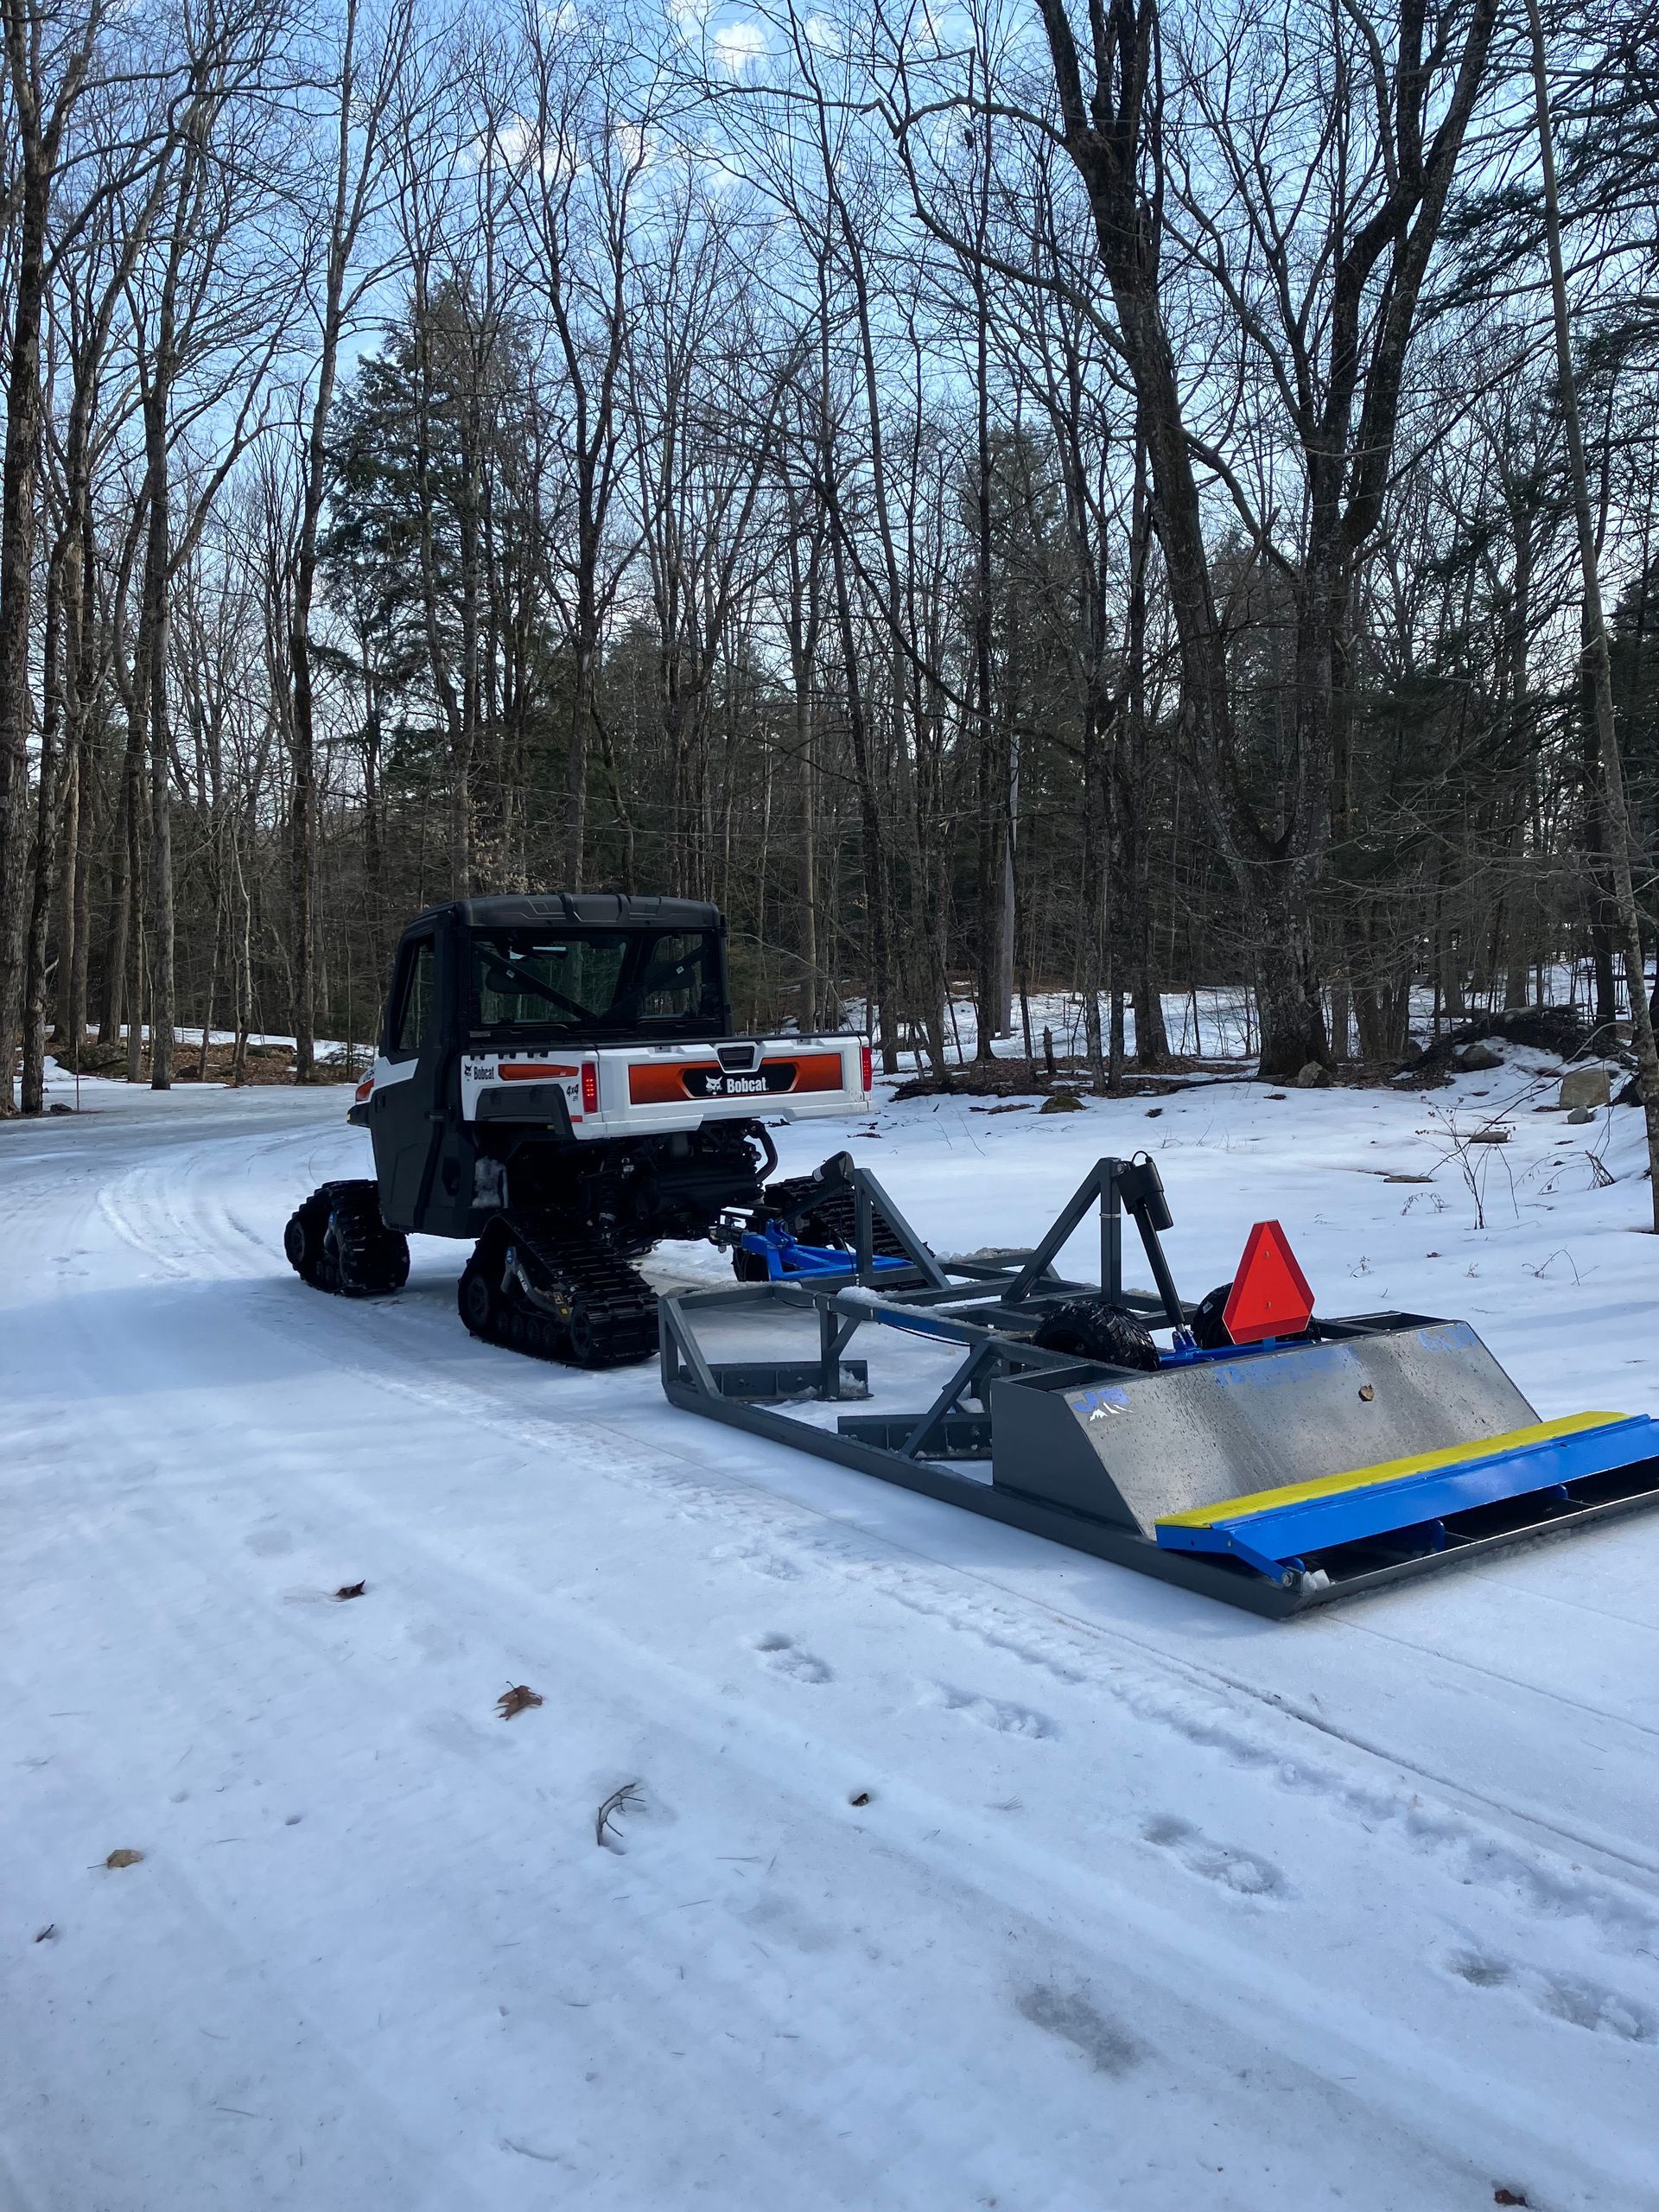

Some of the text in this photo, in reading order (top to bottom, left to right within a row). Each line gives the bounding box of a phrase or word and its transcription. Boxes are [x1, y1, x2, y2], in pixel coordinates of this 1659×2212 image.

[474, 1065, 495, 1081] Bobcat
[566, 1084, 580, 1096] 4x4
[727, 1077, 766, 1093] Bobcat
